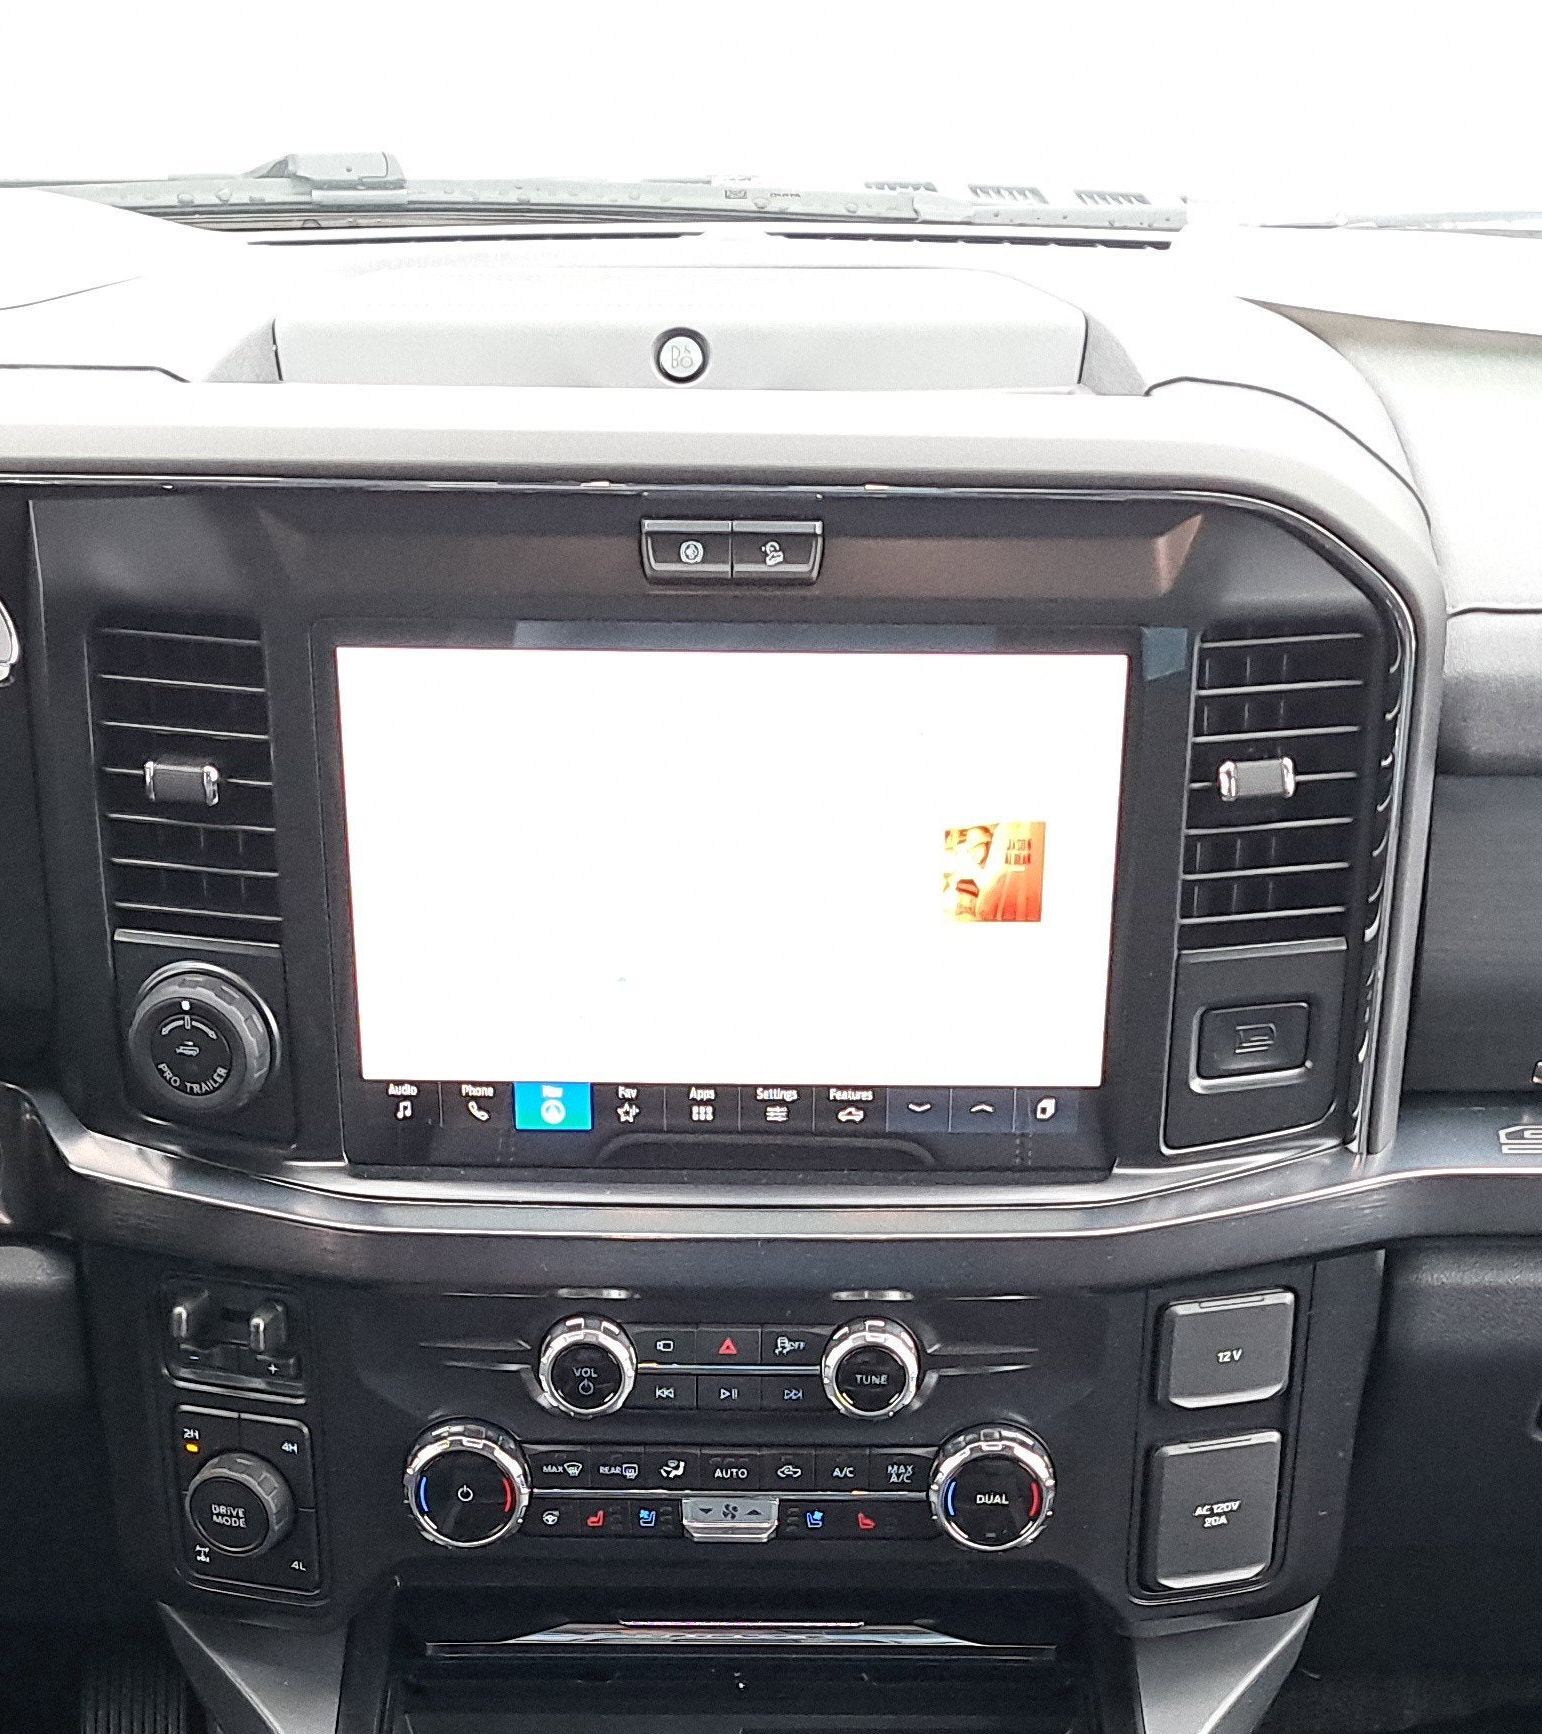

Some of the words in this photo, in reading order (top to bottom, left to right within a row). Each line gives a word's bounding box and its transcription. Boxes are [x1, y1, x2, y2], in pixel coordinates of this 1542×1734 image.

[158, 1063, 181, 1087] PRO
[185, 1066, 228, 1095] TRAILER
[388, 1084, 417, 1097] Audio
[461, 1084, 494, 1098] Phone
[618, 1086, 638, 1099] Fav
[689, 1087, 715, 1102] Apps
[756, 1088, 799, 1103] Settings
[829, 1088, 873, 1102] Features
[572, 1367, 598, 1379] VOL
[854, 1374, 889, 1386] TUNE
[183, 1428, 199, 1440] 2H
[281, 1442, 298, 1455] 4H
[542, 1464, 564, 1474] MAX
[599, 1466, 622, 1475] REAR
[714, 1467, 748, 1479] AUTO
[832, 1466, 855, 1478] A/C
[887, 1464, 913, 1474] MAX
[889, 1473, 912, 1483] A/C
[976, 1493, 1009, 1505] DUAL
[211, 1503, 245, 1518] DRIVE
[1193, 1504, 1211, 1516] AC
[1212, 1500, 1241, 1514] 120V
[212, 1515, 247, 1528] MODE
[291, 1560, 306, 1572] 4L
